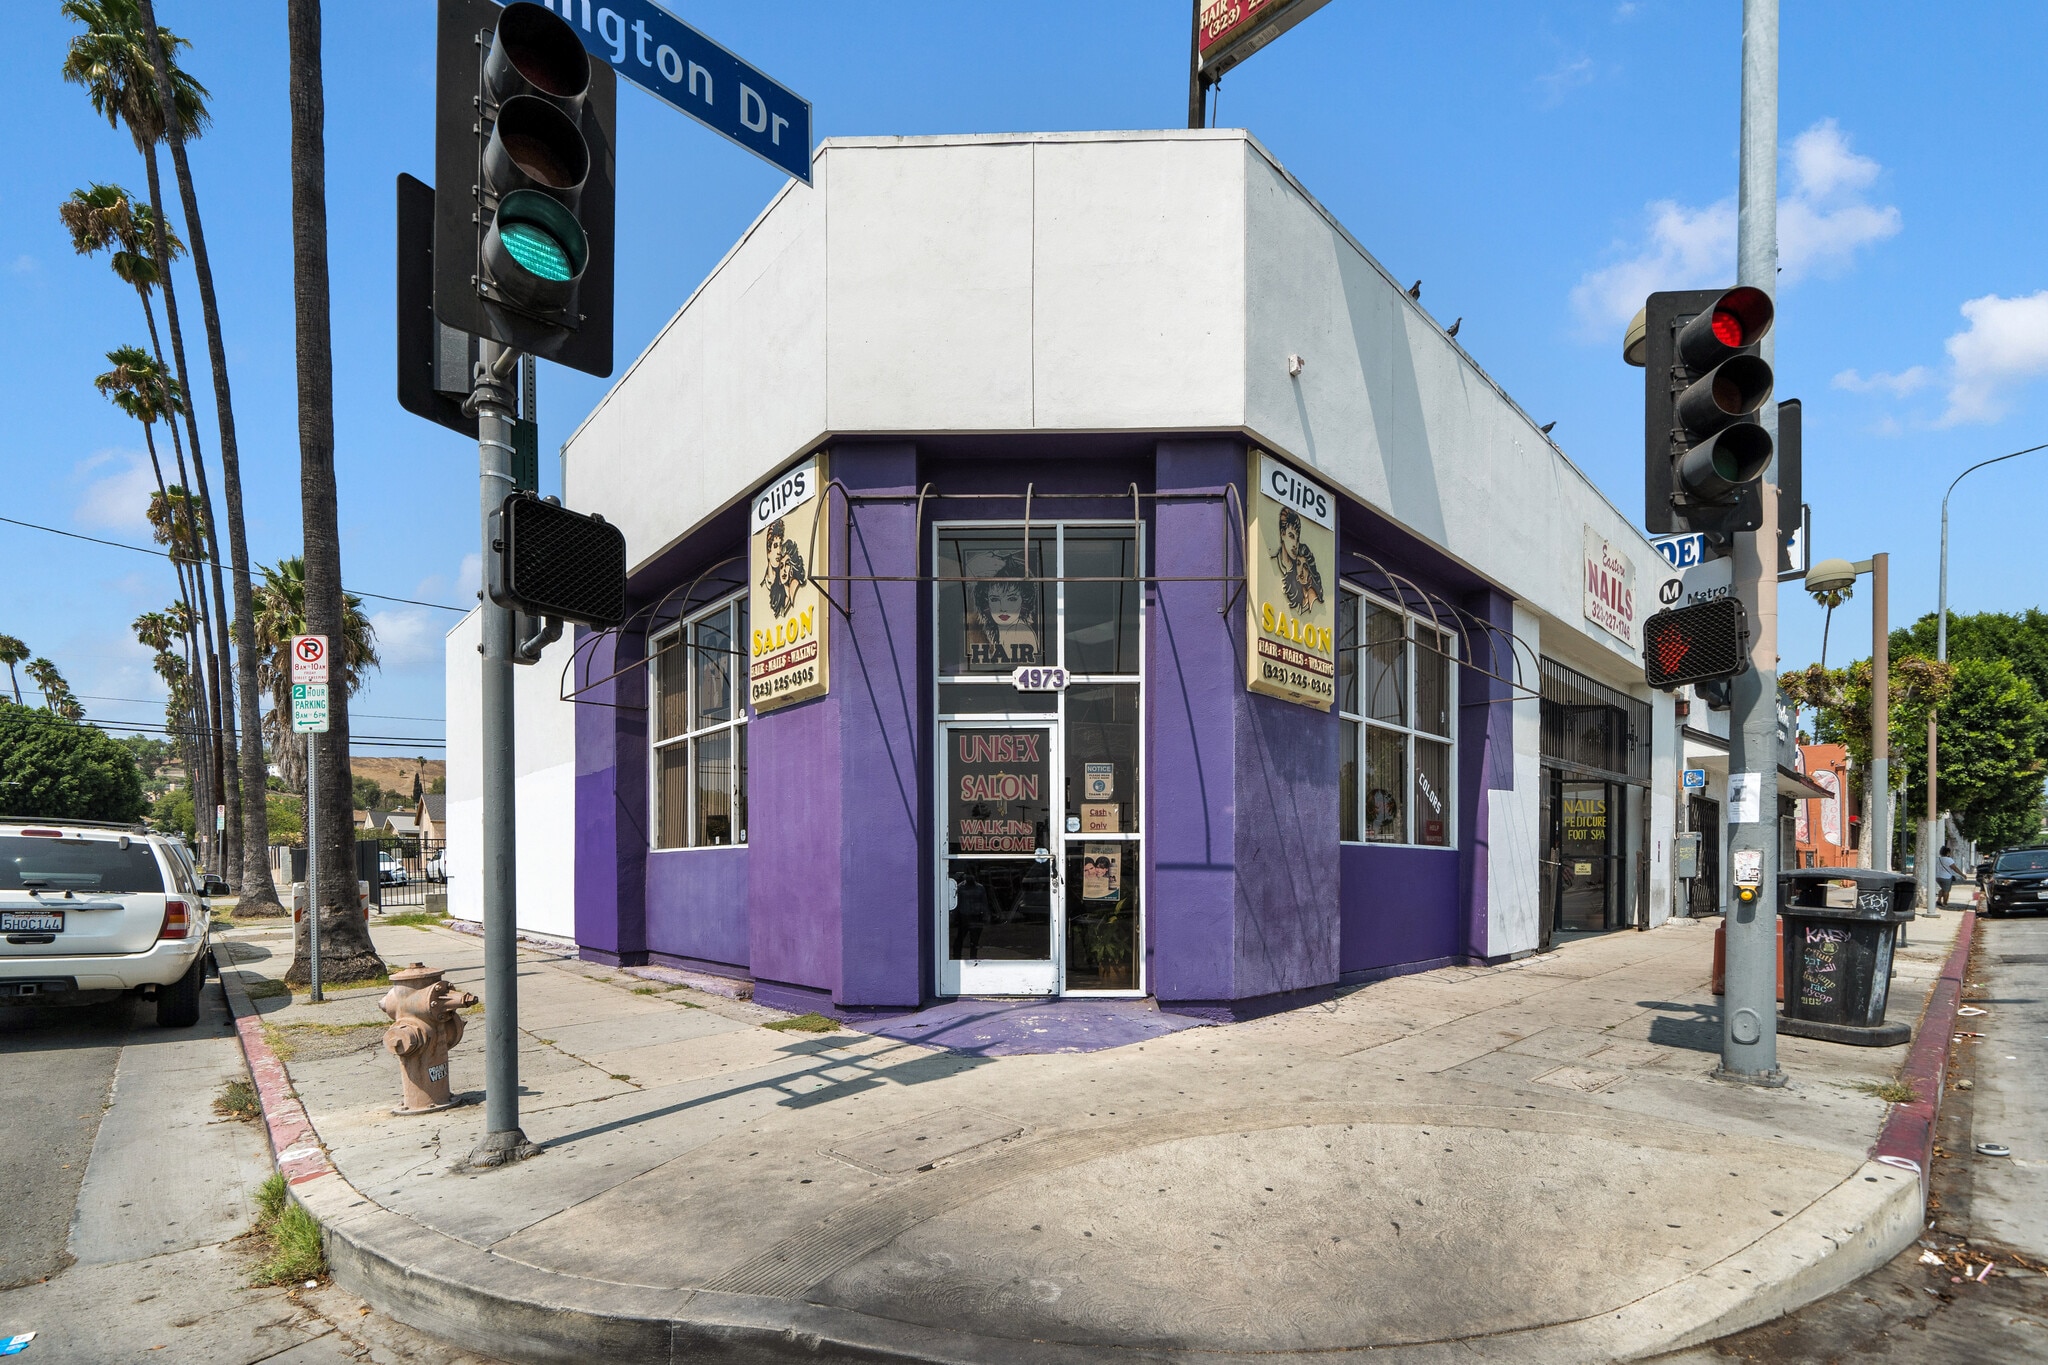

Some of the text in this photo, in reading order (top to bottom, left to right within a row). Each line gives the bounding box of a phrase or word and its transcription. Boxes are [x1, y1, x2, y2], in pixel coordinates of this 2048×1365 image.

[1200, 0, 1228, 30] HAIR
[1209, 4, 1240, 38] (323)
[544, 0, 789, 146] ngton Dr
[758, 471, 806, 521] Clips
[1271, 470, 1327, 518] Clips
[1588, 558, 1633, 622] NAILS
[752, 605, 814, 657] SALON
[1261, 602, 1332, 654] SALON
[971, 643, 1035, 664] HAIR
[1258, 640, 1334, 676] HAIR NAILS WAXING
[1018, 669, 1065, 689] 4973
[1262, 661, 1288, 685] (323)
[295, 686, 326, 698] 2 HOUR
[752, 679, 772, 701] (323)
[295, 700, 326, 710] PARKING
[960, 734, 1040, 763] UNISEX
[961, 774, 1038, 801] SALON
[1419, 772, 1442, 815] COLORS
[1089, 808, 1107, 817] Cash
[1564, 800, 1606, 814] NAILS
[961, 819, 1033, 835] WALK-INS
[1089, 822, 1107, 830] Only
[1568, 829, 1606, 840] FOOT SPA
[959, 836, 1036, 851] WELCOME
